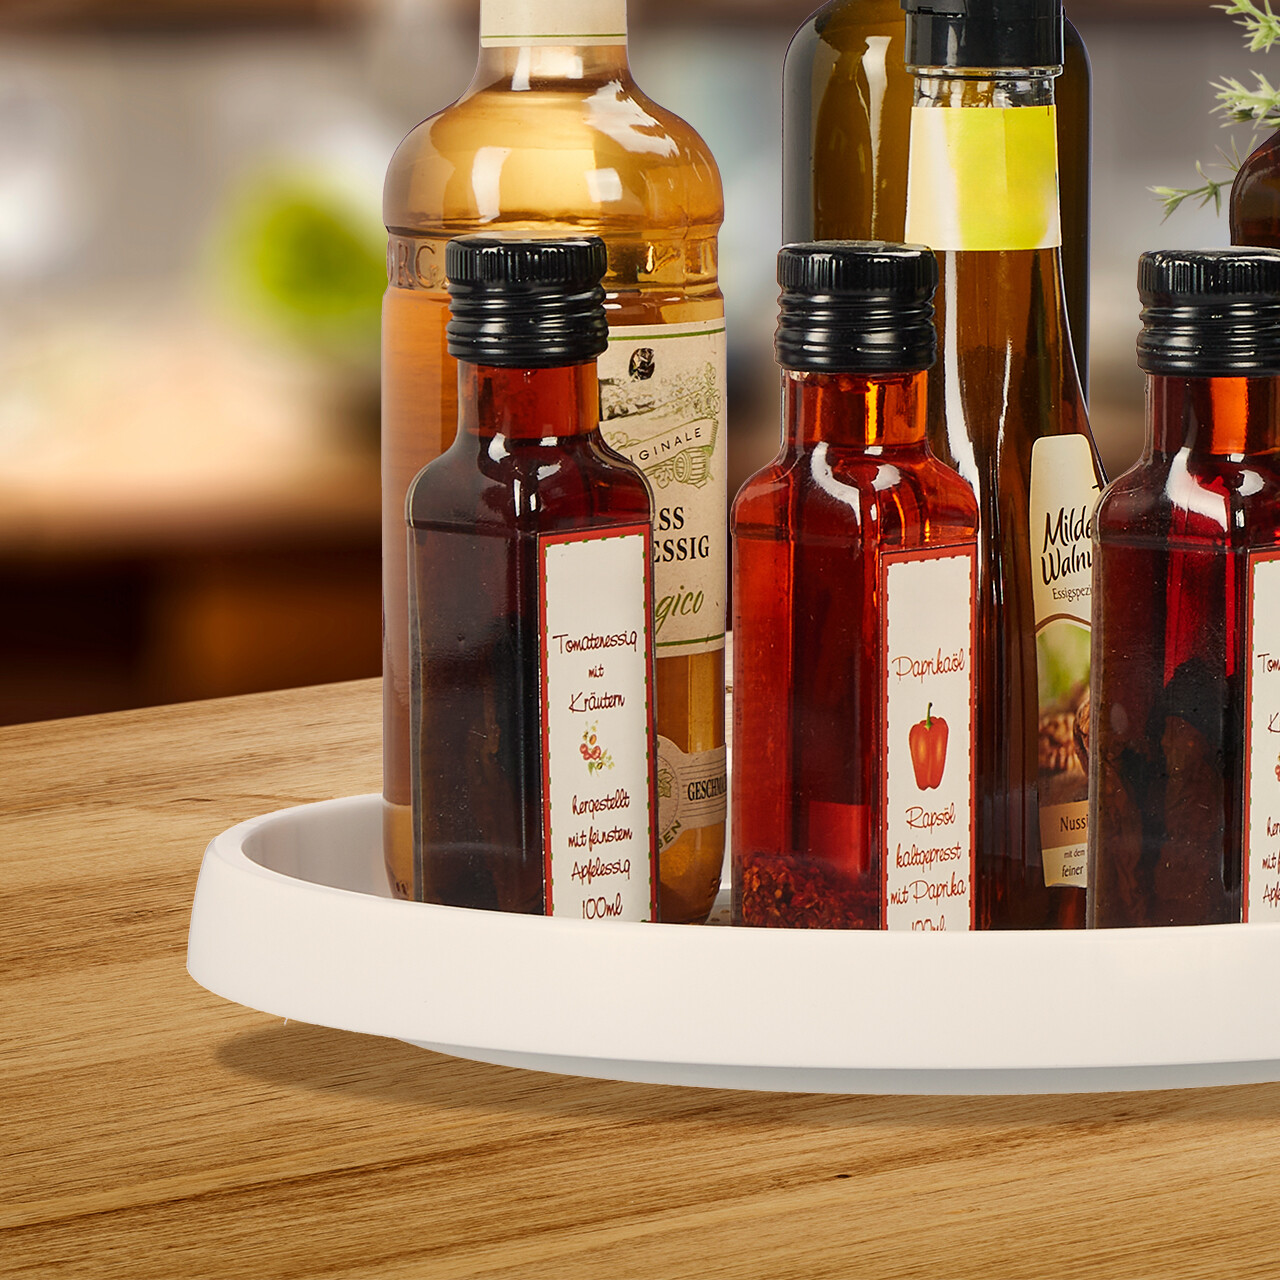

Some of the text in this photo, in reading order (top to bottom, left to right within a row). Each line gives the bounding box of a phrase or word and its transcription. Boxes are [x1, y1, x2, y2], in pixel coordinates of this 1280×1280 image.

[629, 426, 702, 463] IGINALE
[653, 505, 685, 532] SS
[1042, 505, 1093, 554] Milde
[1040, 543, 1093, 586] Walnu
[1052, 583, 1093, 602] Essigspezi
[655, 584, 705, 636] gico
[588, 663, 605, 679] mit
[891, 647, 966, 684] Paprikaöl
[568, 691, 626, 714] Kräutern
[571, 787, 631, 821] hergestellt
[905, 801, 957, 835] Rapsöl
[568, 825, 633, 853] mit feinstem
[895, 841, 962, 873] kaltgepresst
[1061, 864, 1084, 878] feiner
[1262, 851, 1277, 871] mit
[890, 871, 967, 907] mit Paprika
[582, 892, 624, 920] 100ml
